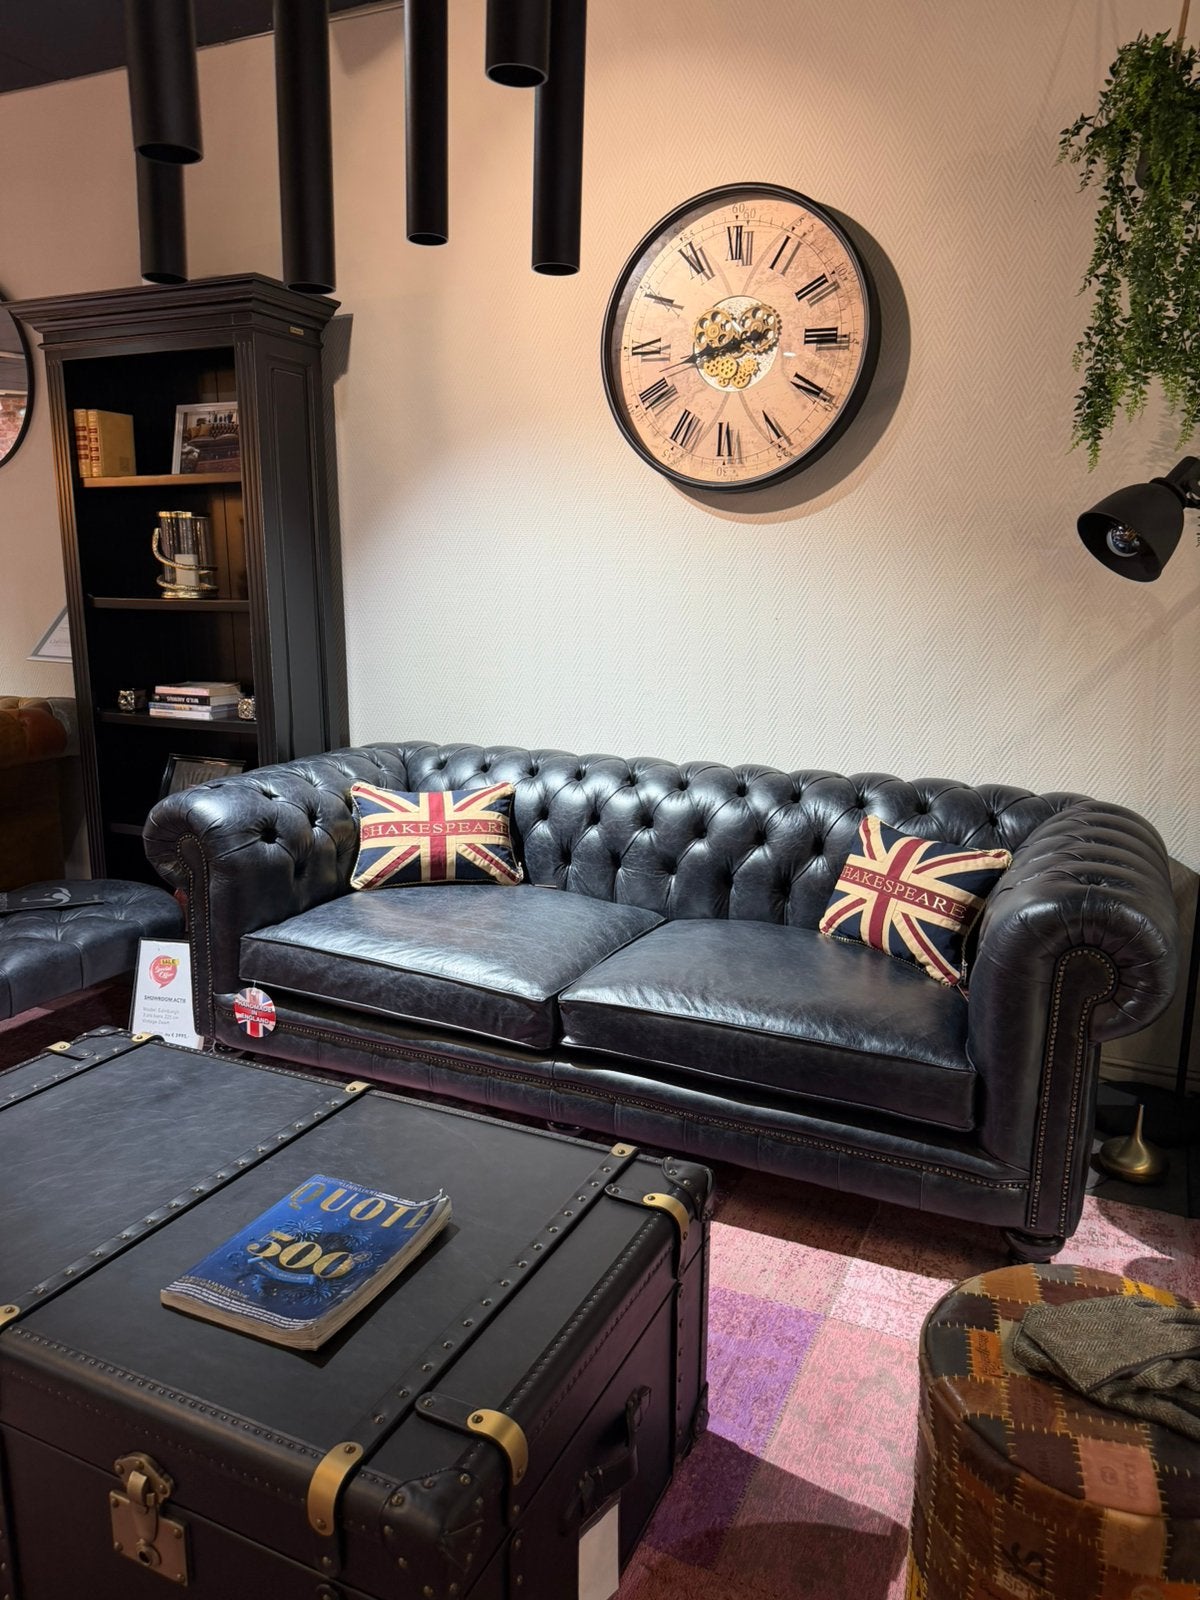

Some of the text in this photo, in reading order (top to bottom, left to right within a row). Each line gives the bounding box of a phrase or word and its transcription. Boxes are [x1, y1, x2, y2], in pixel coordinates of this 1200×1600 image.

[731, 202, 746, 214] 60
[725, 224, 743, 261] XII
[769, 235, 792, 271] I
[677, 240, 706, 280] XI
[794, 272, 829, 302] II
[631, 337, 662, 357] IX
[803, 326, 839, 345] III
[362, 820, 510, 839] SHAKESPEARE
[239, 1000, 272, 1012] HANDMADE
[243, 1014, 269, 1025] ENGLAND
[287, 1181, 431, 1230] QUOTE
[246, 1229, 354, 1279] 500
